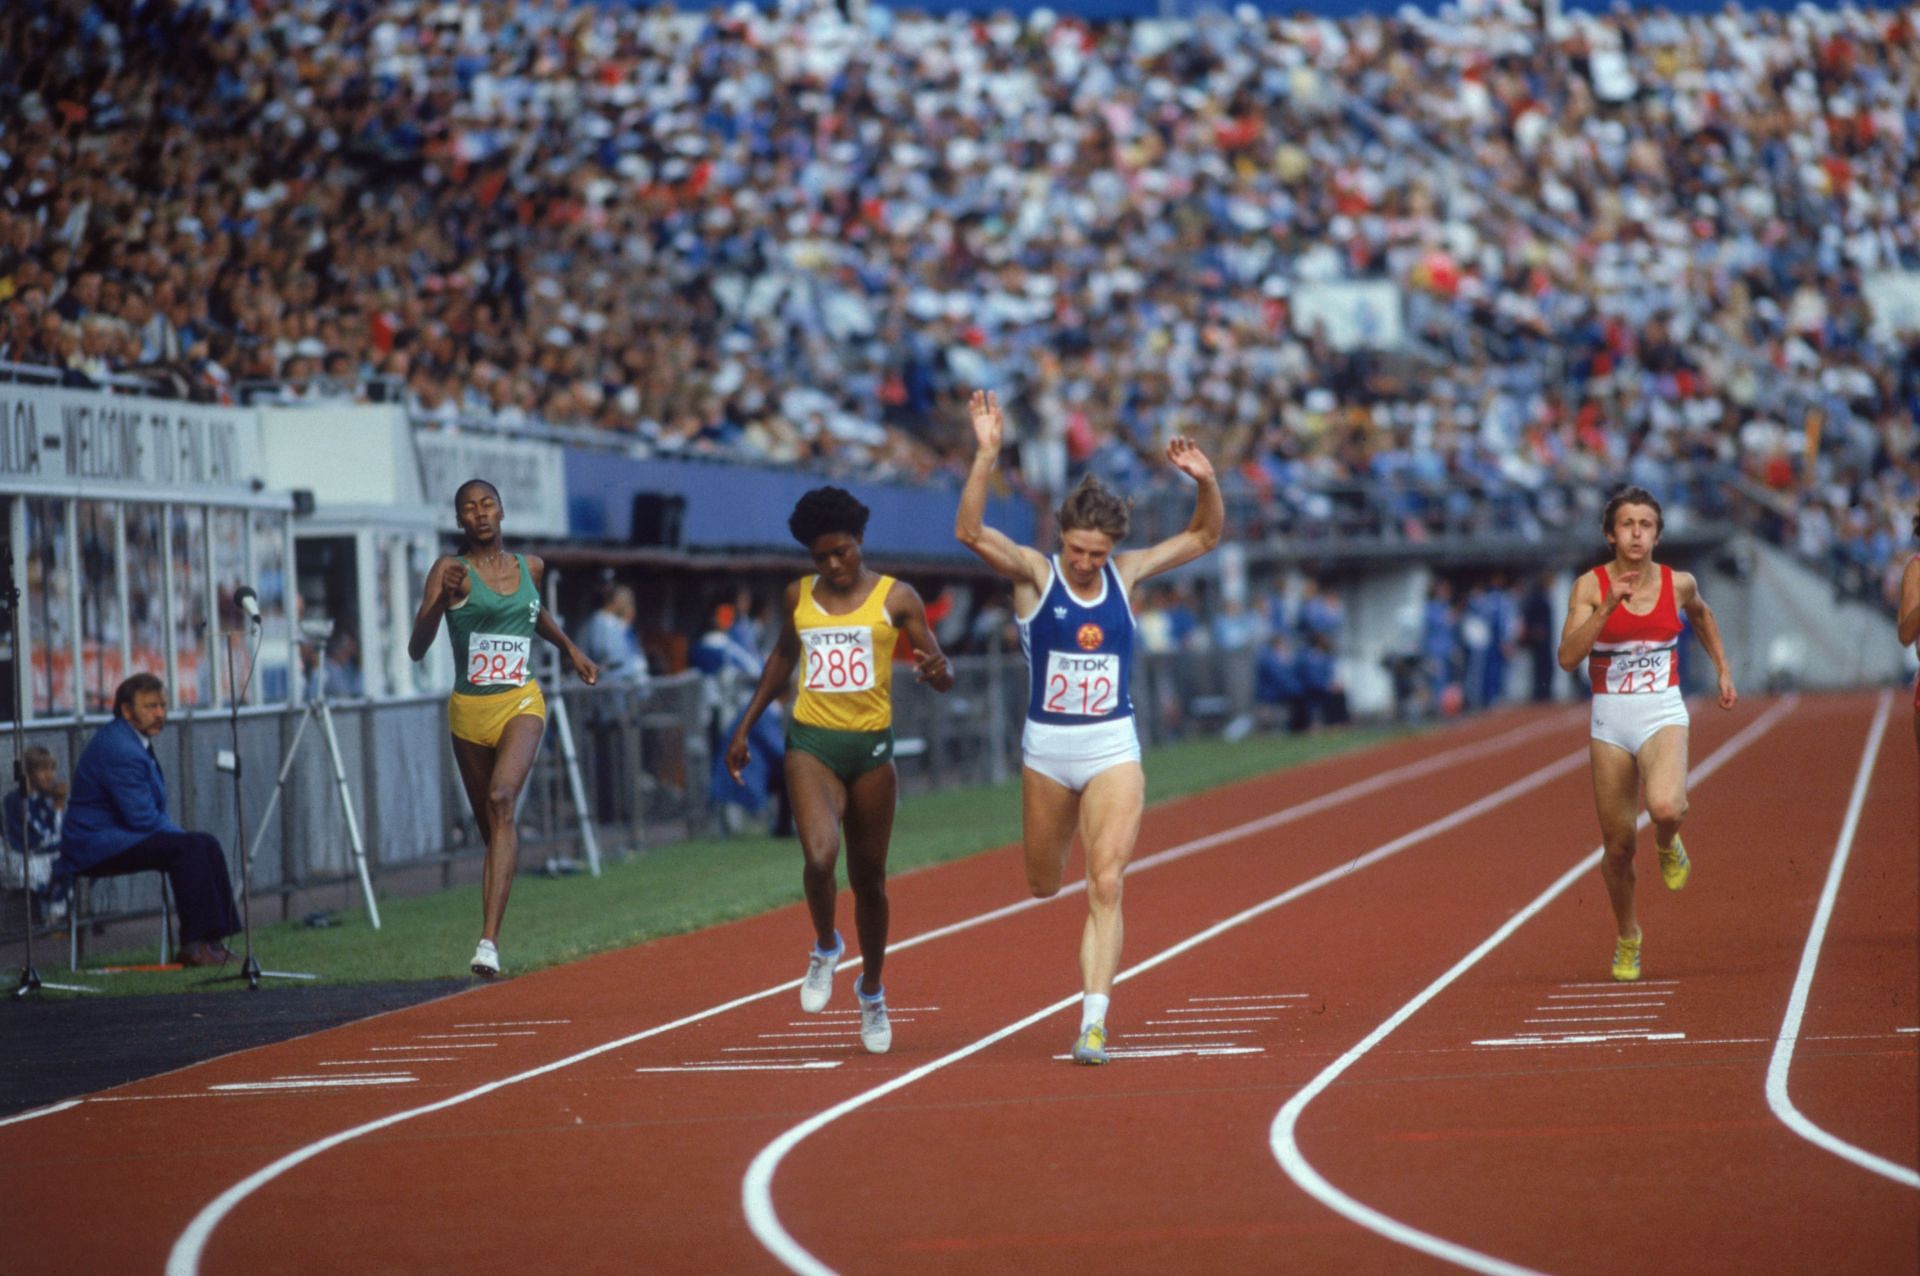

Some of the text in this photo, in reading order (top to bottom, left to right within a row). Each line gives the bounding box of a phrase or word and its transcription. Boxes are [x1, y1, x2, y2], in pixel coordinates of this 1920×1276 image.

[821, 630, 861, 645] TDK
[490, 640, 524, 652] TDK
[470, 652, 525, 684] 284
[808, 646, 868, 689] 286
[1071, 658, 1109, 672] TDK
[1628, 655, 1662, 668] TDK
[1047, 673, 1112, 715] 212
